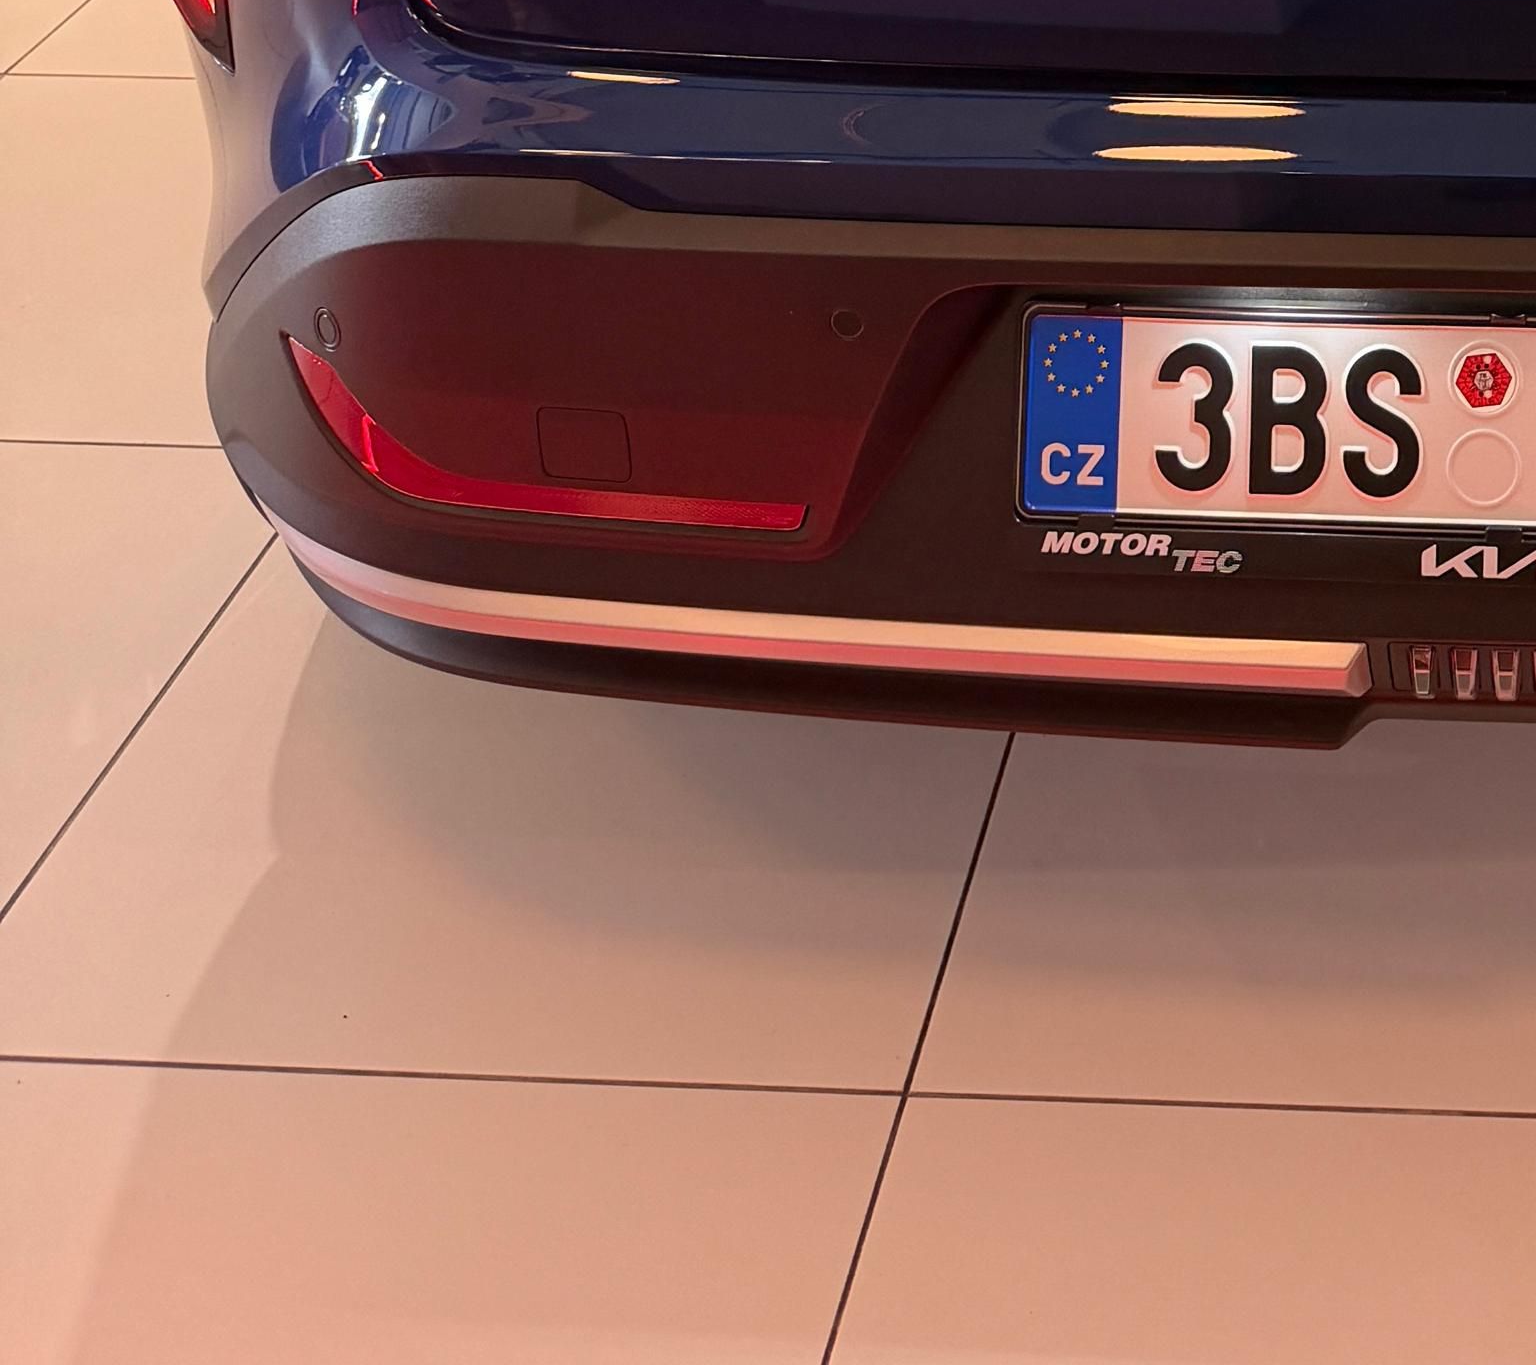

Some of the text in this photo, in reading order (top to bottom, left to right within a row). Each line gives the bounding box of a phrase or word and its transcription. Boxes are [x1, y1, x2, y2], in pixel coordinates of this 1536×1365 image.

[1154, 342, 1422, 498] 3BS
[1041, 442, 1105, 486] CZ
[1041, 531, 1243, 573] MOTOR TEC
